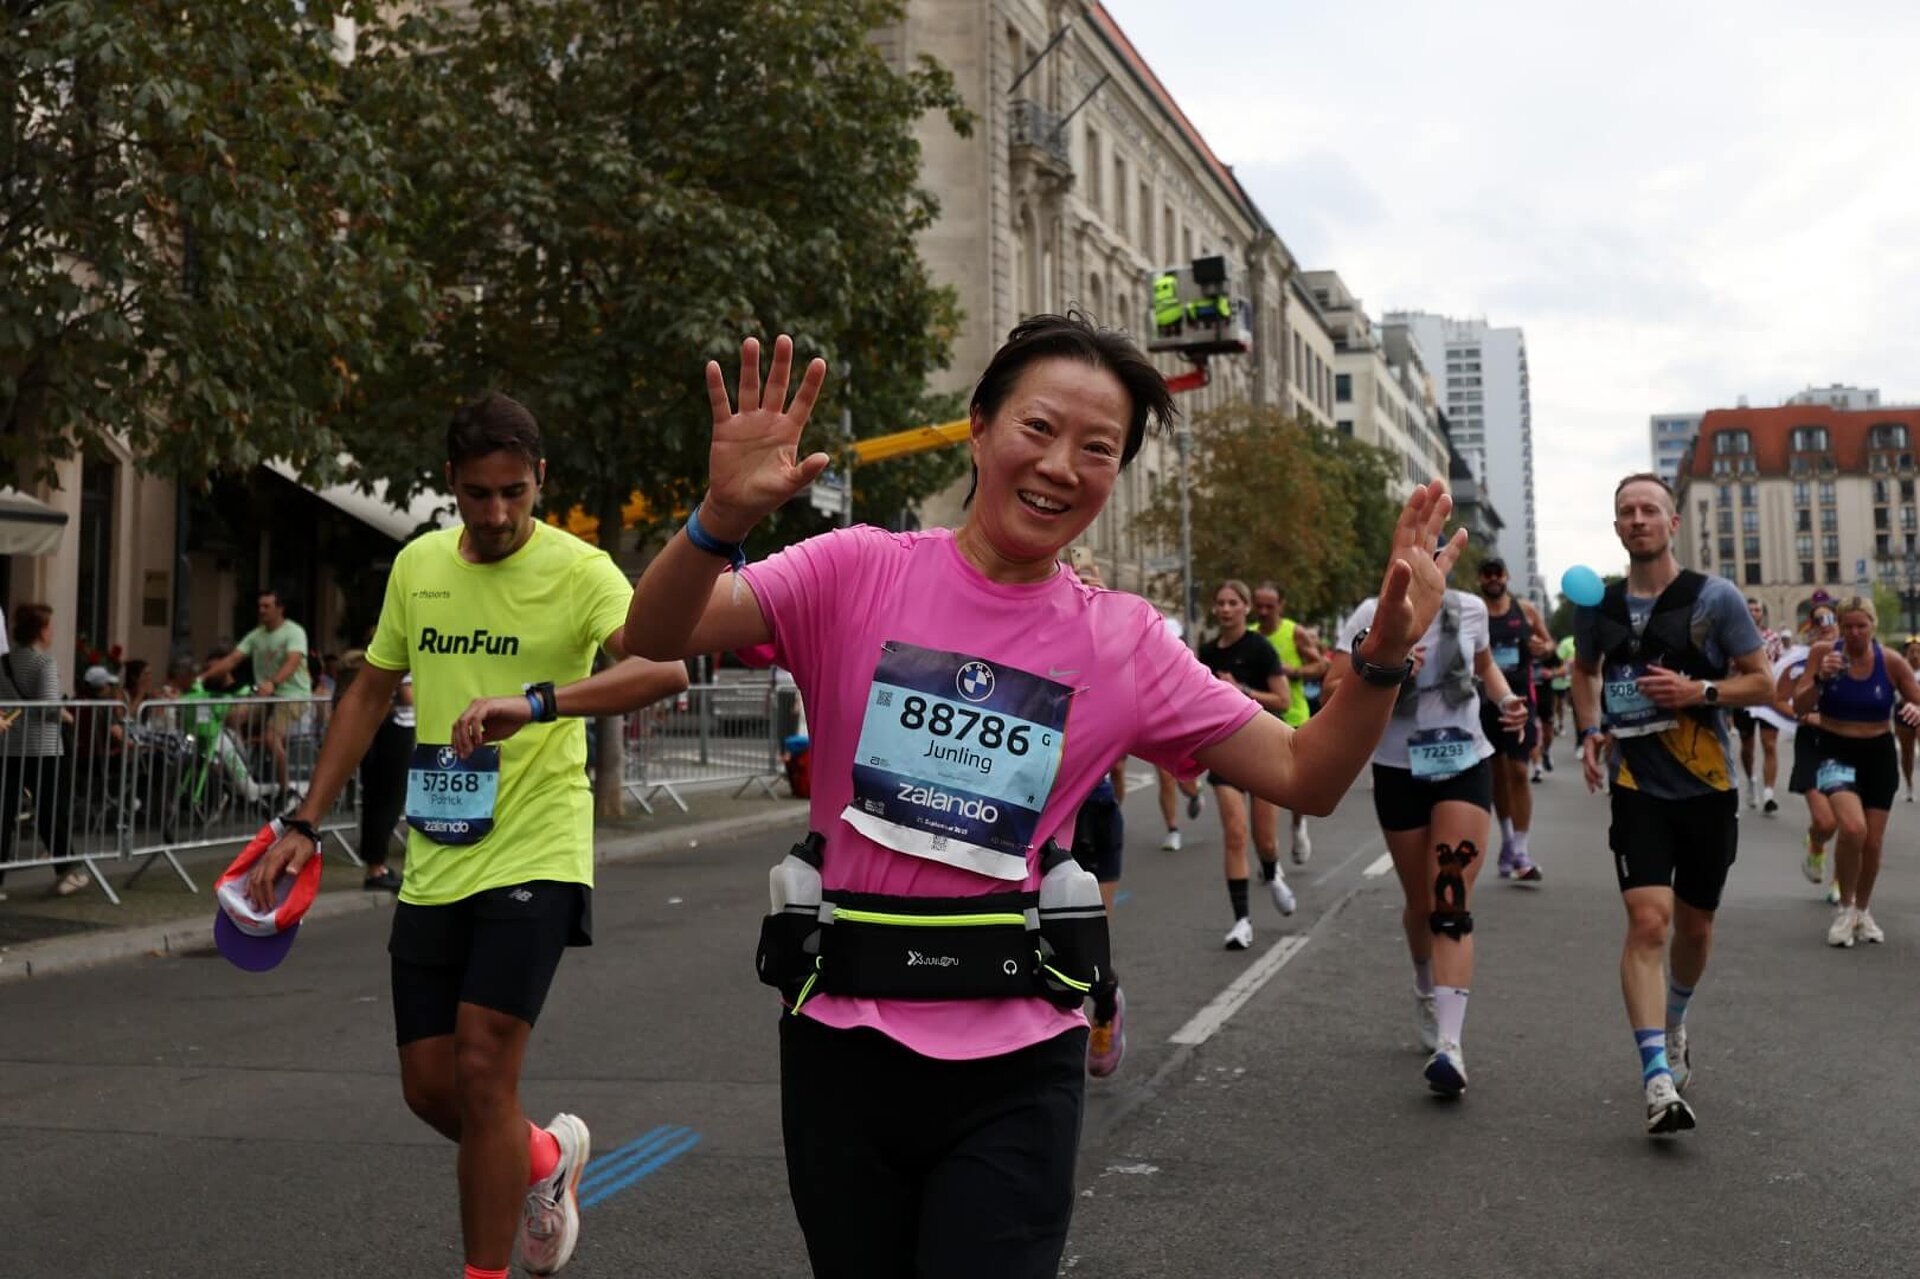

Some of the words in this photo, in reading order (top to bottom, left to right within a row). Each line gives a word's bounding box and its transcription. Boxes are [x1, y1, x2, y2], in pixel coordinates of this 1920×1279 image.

[418, 627, 519, 656] RunFun
[1610, 683, 1639, 697] 508
[900, 696, 1031, 756] 88786
[1042, 733, 1051, 747] G
[1422, 744, 1464, 759] 72293
[924, 740, 992, 774] Junling
[423, 772, 479, 793] 57368
[897, 782, 998, 824] zalando
